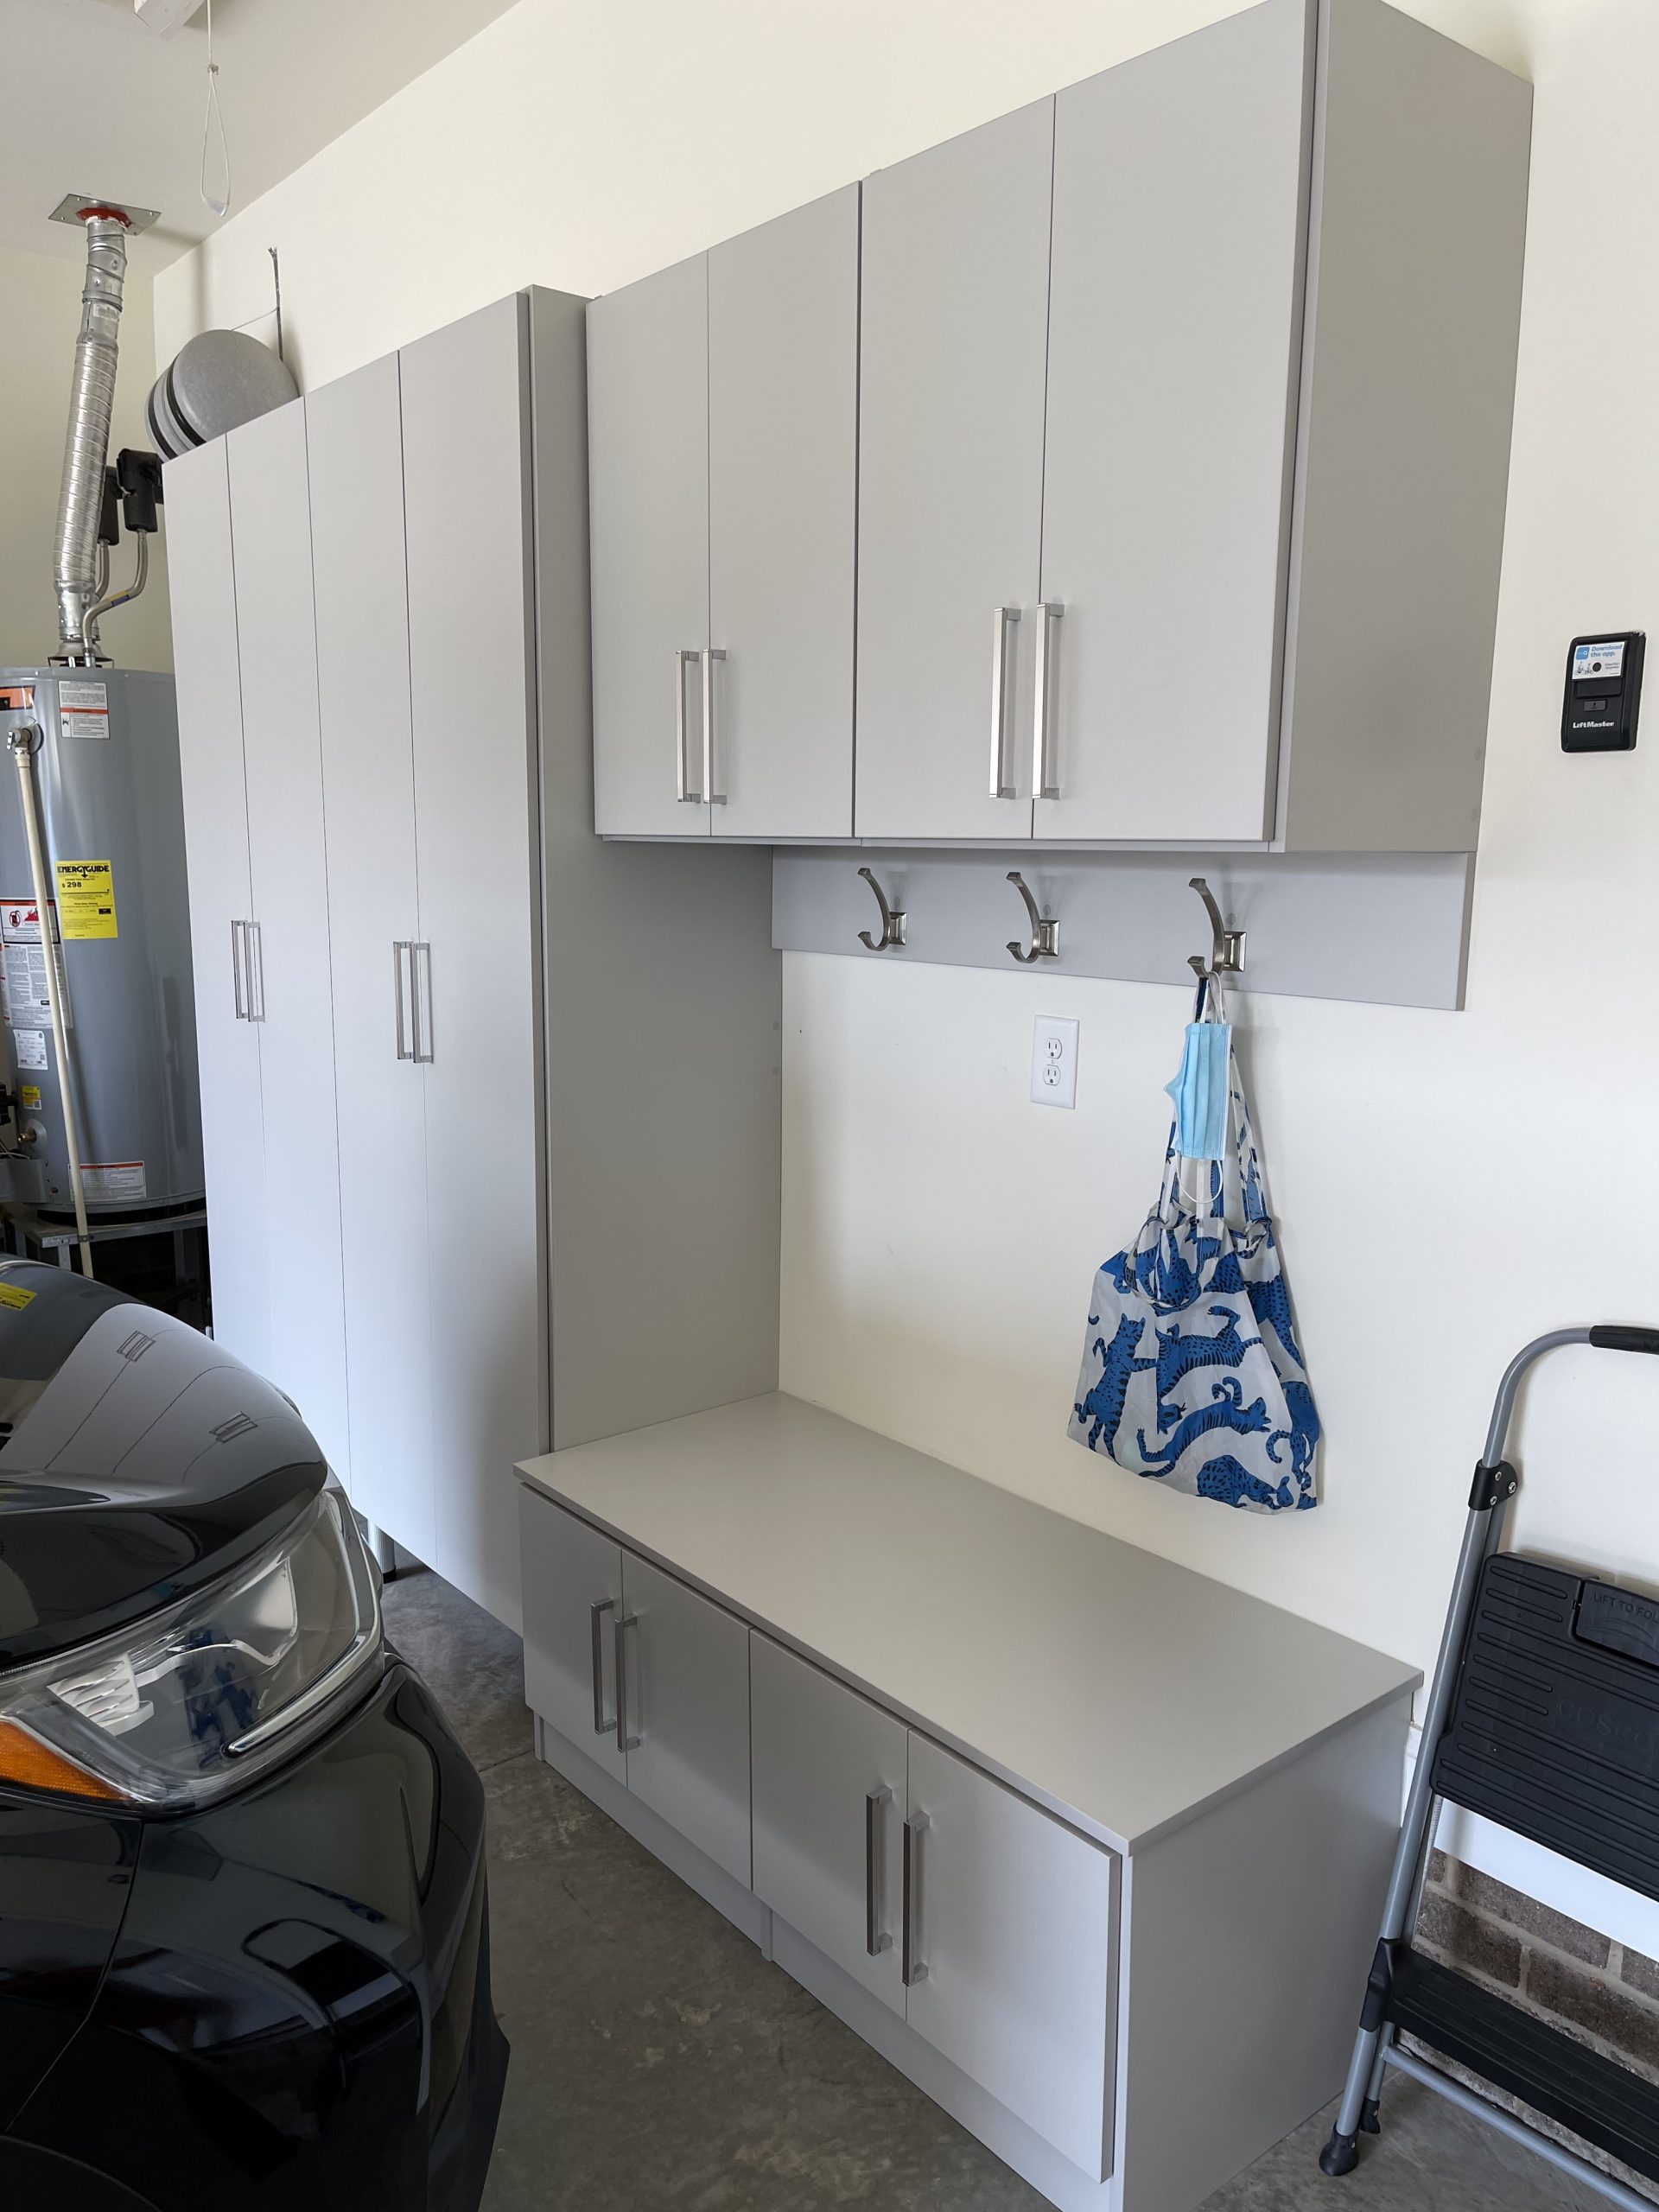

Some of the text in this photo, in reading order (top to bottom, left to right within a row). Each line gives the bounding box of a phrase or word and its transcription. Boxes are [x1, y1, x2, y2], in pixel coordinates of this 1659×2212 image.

[1593, 1592, 1659, 1623] LIFT TO FOL
